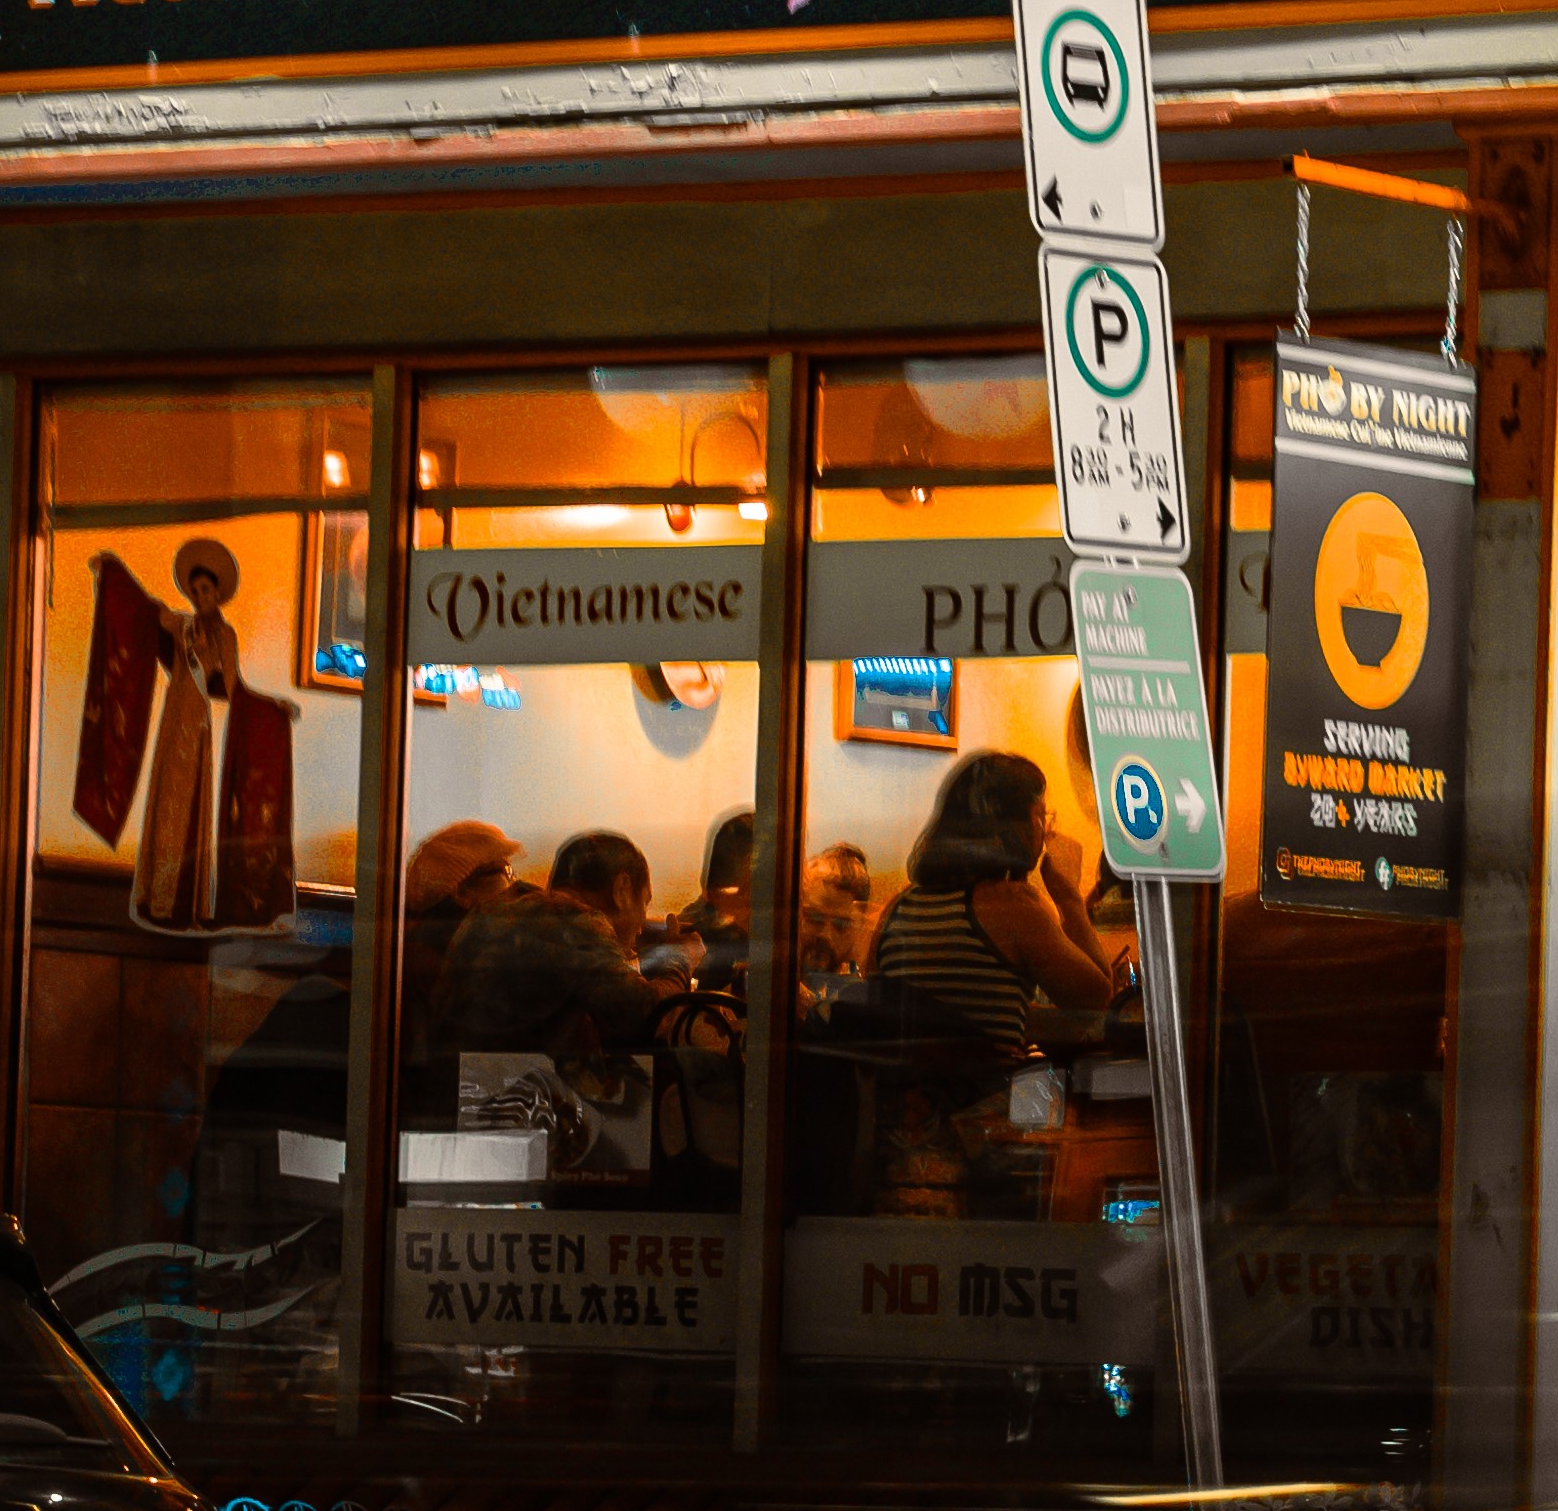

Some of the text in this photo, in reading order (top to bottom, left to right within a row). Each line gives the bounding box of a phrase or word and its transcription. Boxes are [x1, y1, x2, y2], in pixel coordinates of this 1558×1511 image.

[1090, 296, 1129, 371] P
[1095, 403, 1137, 447] 2 H
[1349, 381, 1386, 424] BY
[1392, 389, 1472, 439] NIGHT
[427, 569, 744, 644] Vietnamese
[1084, 622, 1148, 656] MACHINE
[1155, 676, 1179, 708] LA
[1094, 704, 1201, 742] DISTRIBUTRICE
[1322, 717, 1411, 764] SERVING
[1283, 750, 1447, 804] BYWARD MARKET
[1353, 797, 1419, 838] YEARS
[404, 1232, 725, 1278] GLUTEN FREE
[425, 1281, 699, 1327] AVAILABLE
[861, 1262, 1078, 1324] NO MSG
